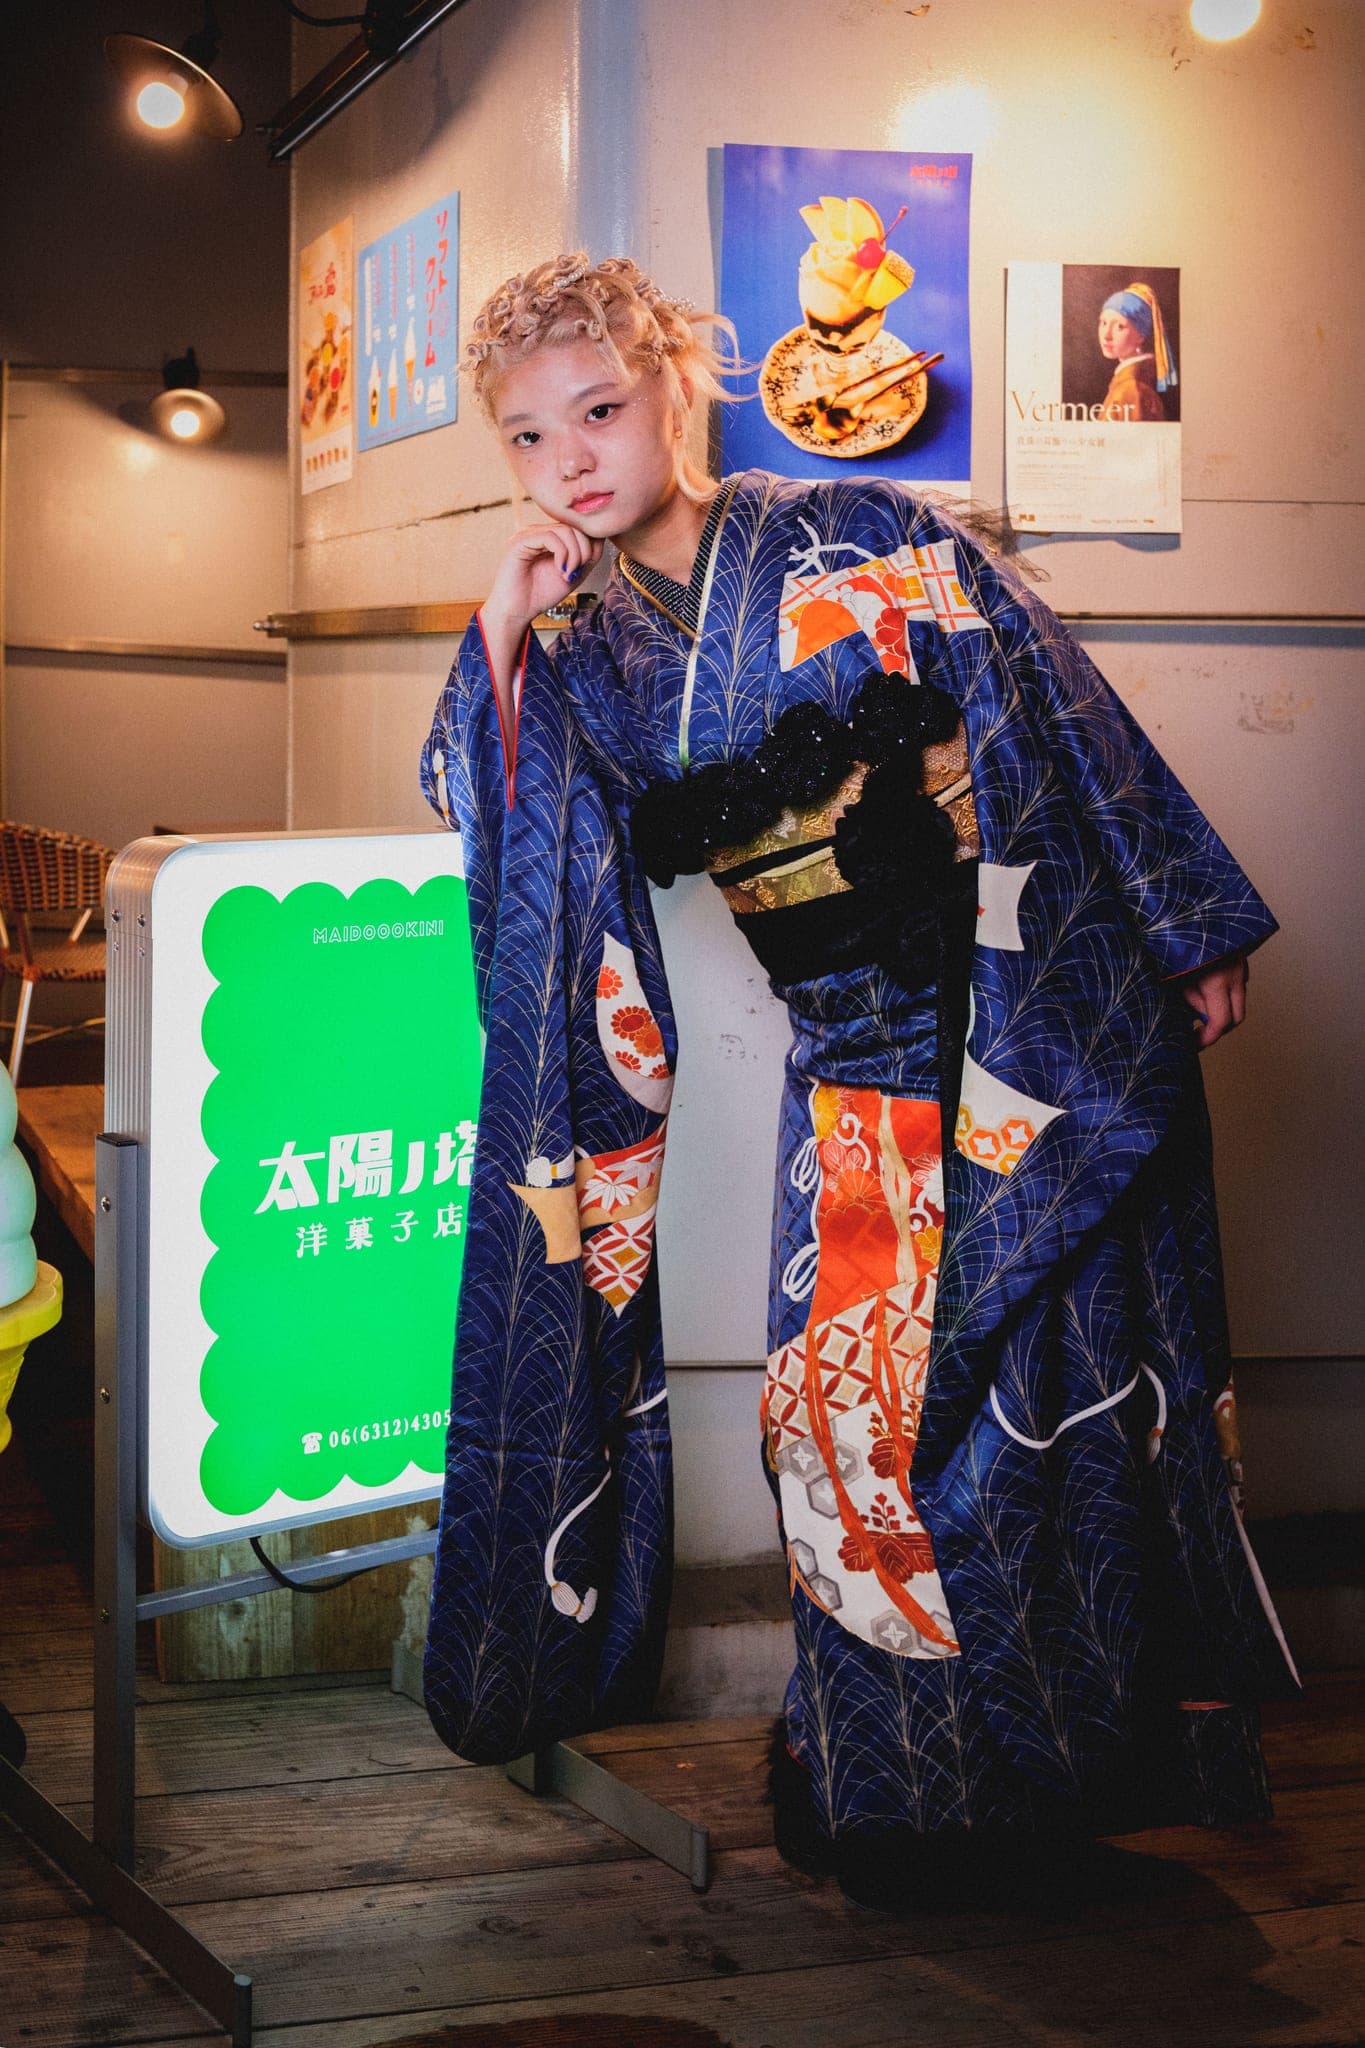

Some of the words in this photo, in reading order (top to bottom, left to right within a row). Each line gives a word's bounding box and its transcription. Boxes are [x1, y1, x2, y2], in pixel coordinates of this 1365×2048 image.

[425, 256, 437, 368] クリーム
[1011, 389, 1136, 423] Vermeer
[313, 920, 444, 944] MAIDOOOKINI
[296, 1202, 463, 1258] 洋菓子店
[328, 1408, 451, 1448] 06(6312)4305
